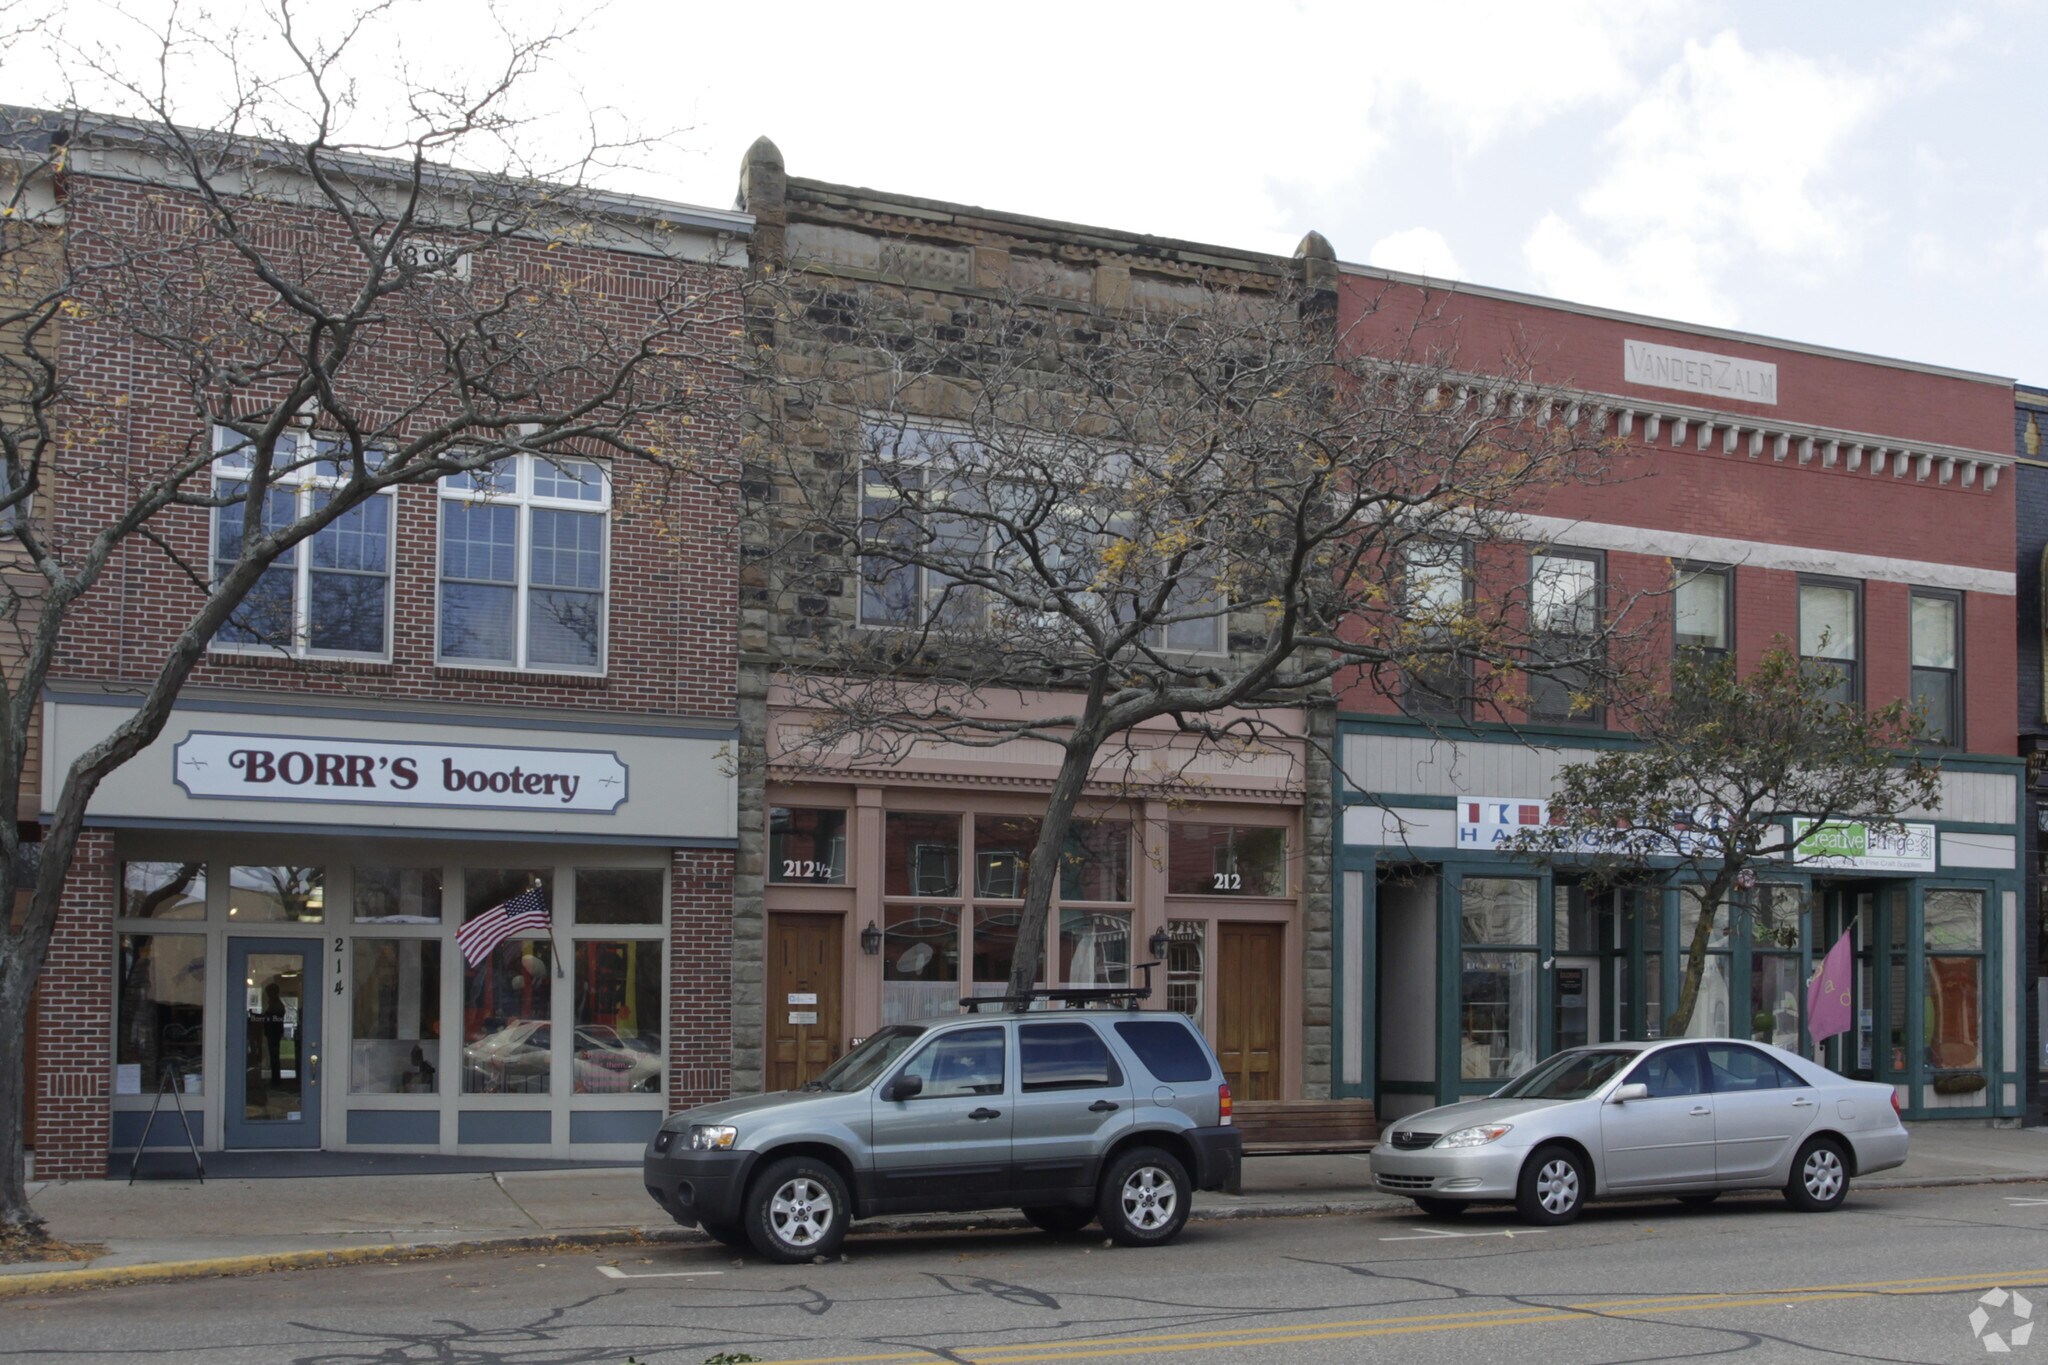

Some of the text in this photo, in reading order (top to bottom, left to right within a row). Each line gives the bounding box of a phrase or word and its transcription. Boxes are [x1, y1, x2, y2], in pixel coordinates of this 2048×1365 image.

[228, 749, 580, 803] BORR'S bootery
[1799, 824, 1864, 850] Creative
[1214, 873, 1241, 889] 212
[334, 938, 344, 995] 214
